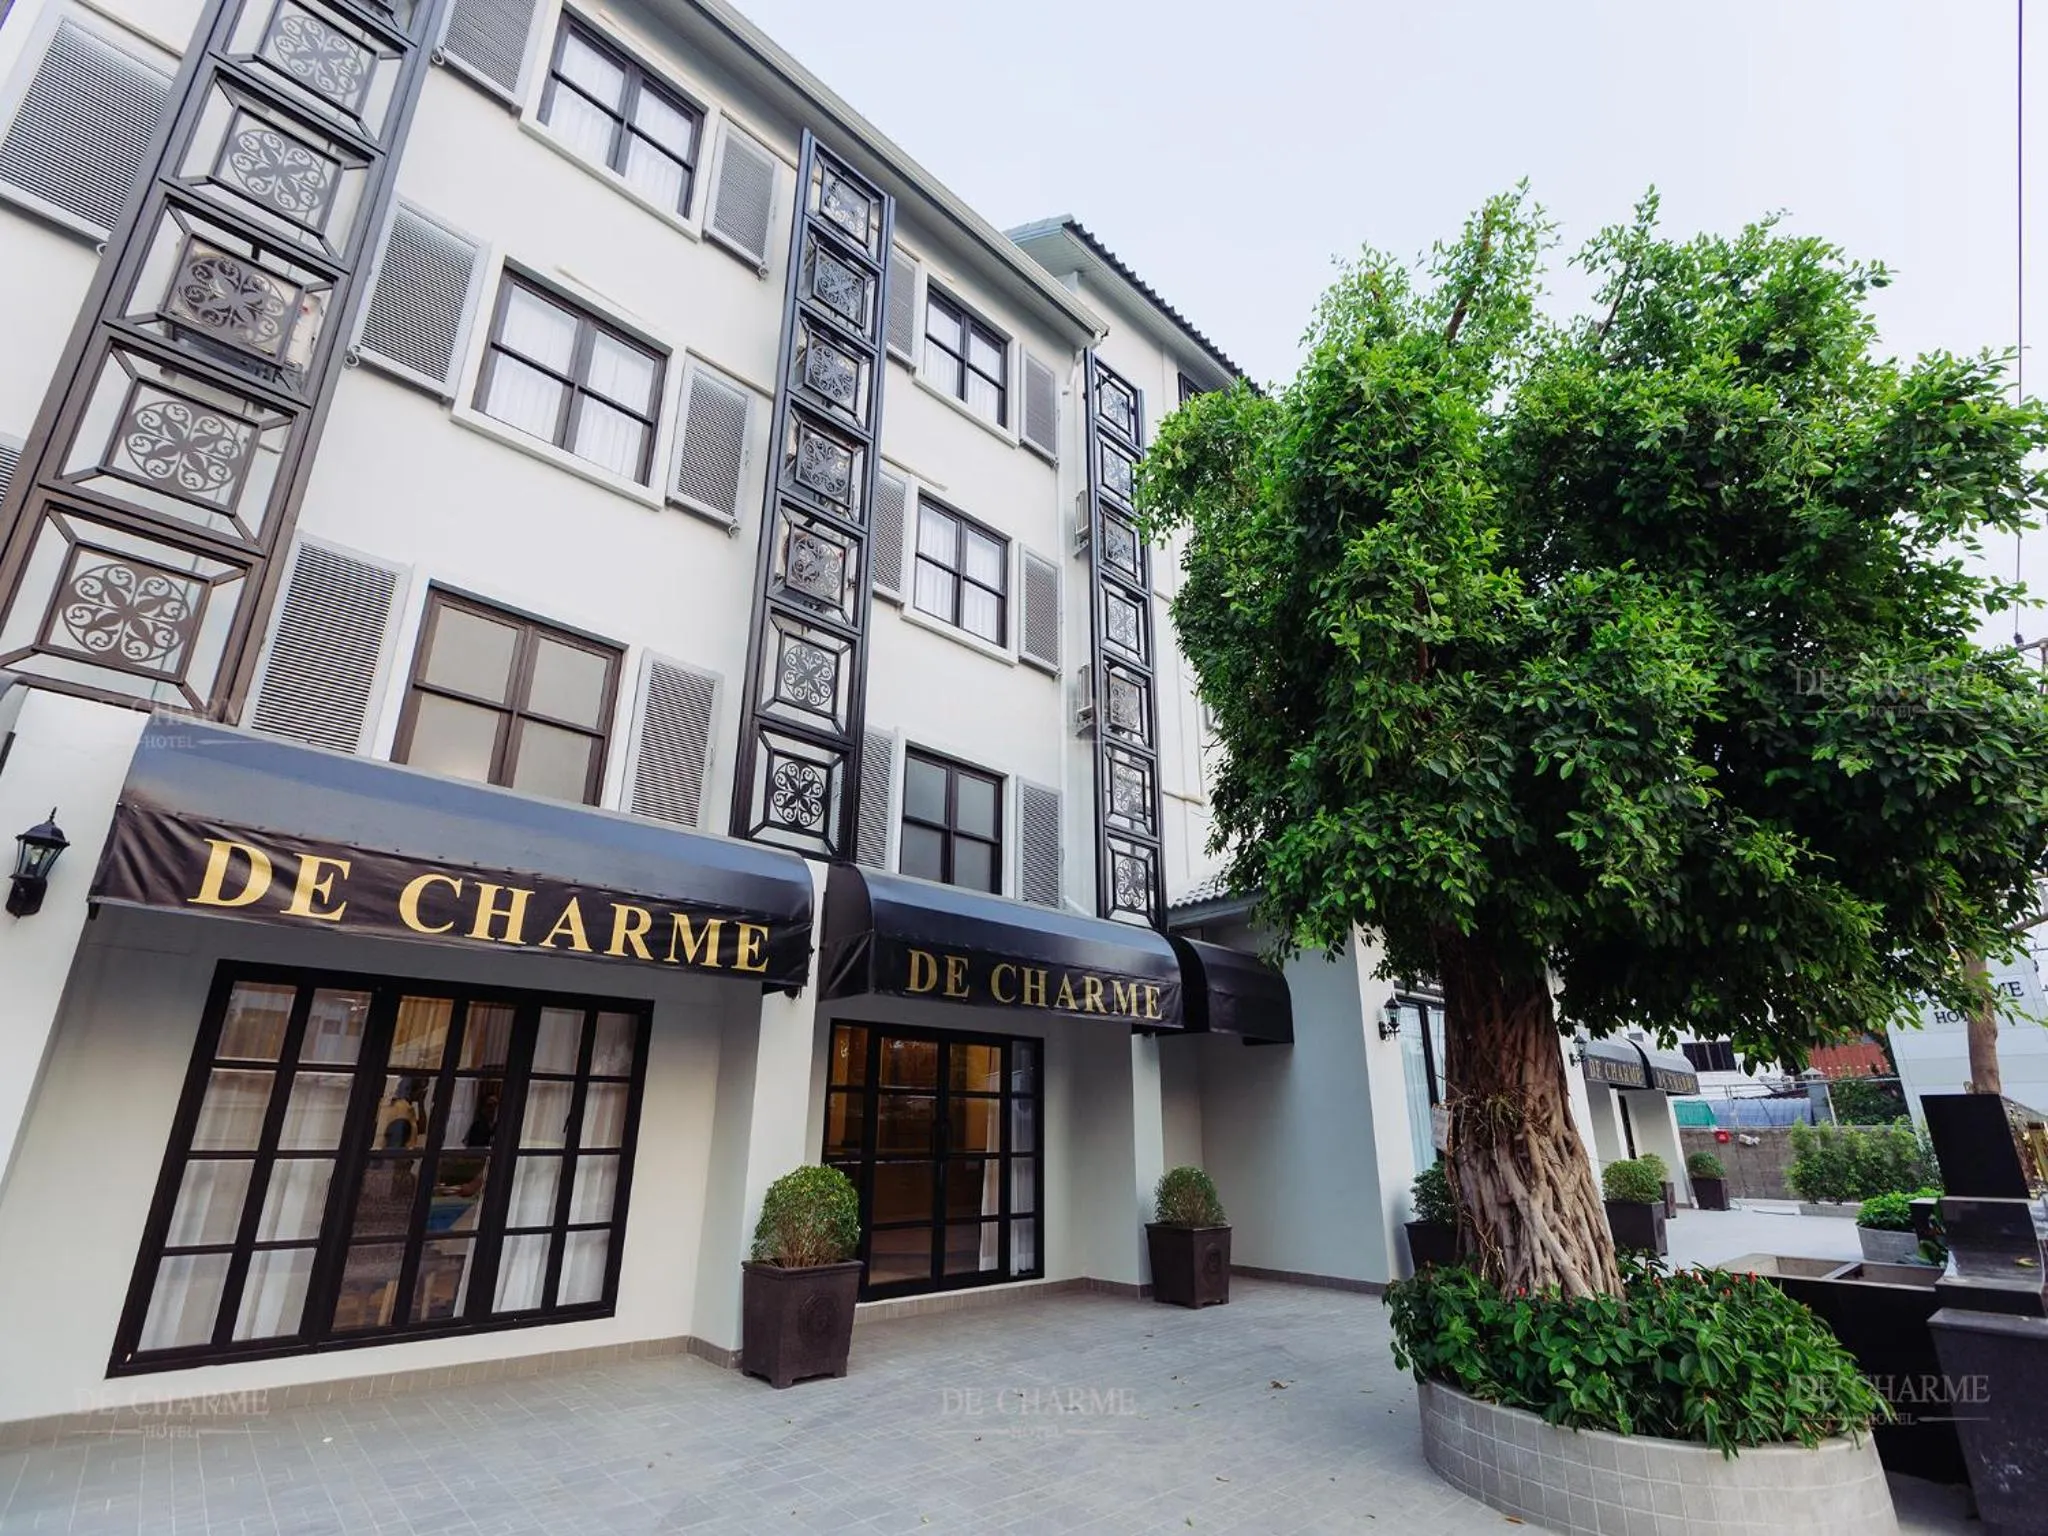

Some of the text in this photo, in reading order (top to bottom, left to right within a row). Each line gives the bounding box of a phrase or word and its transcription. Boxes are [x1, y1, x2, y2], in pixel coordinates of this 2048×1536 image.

[187, 838, 769, 973] DE CHARME
[906, 949, 1163, 1020] DE CHARME
